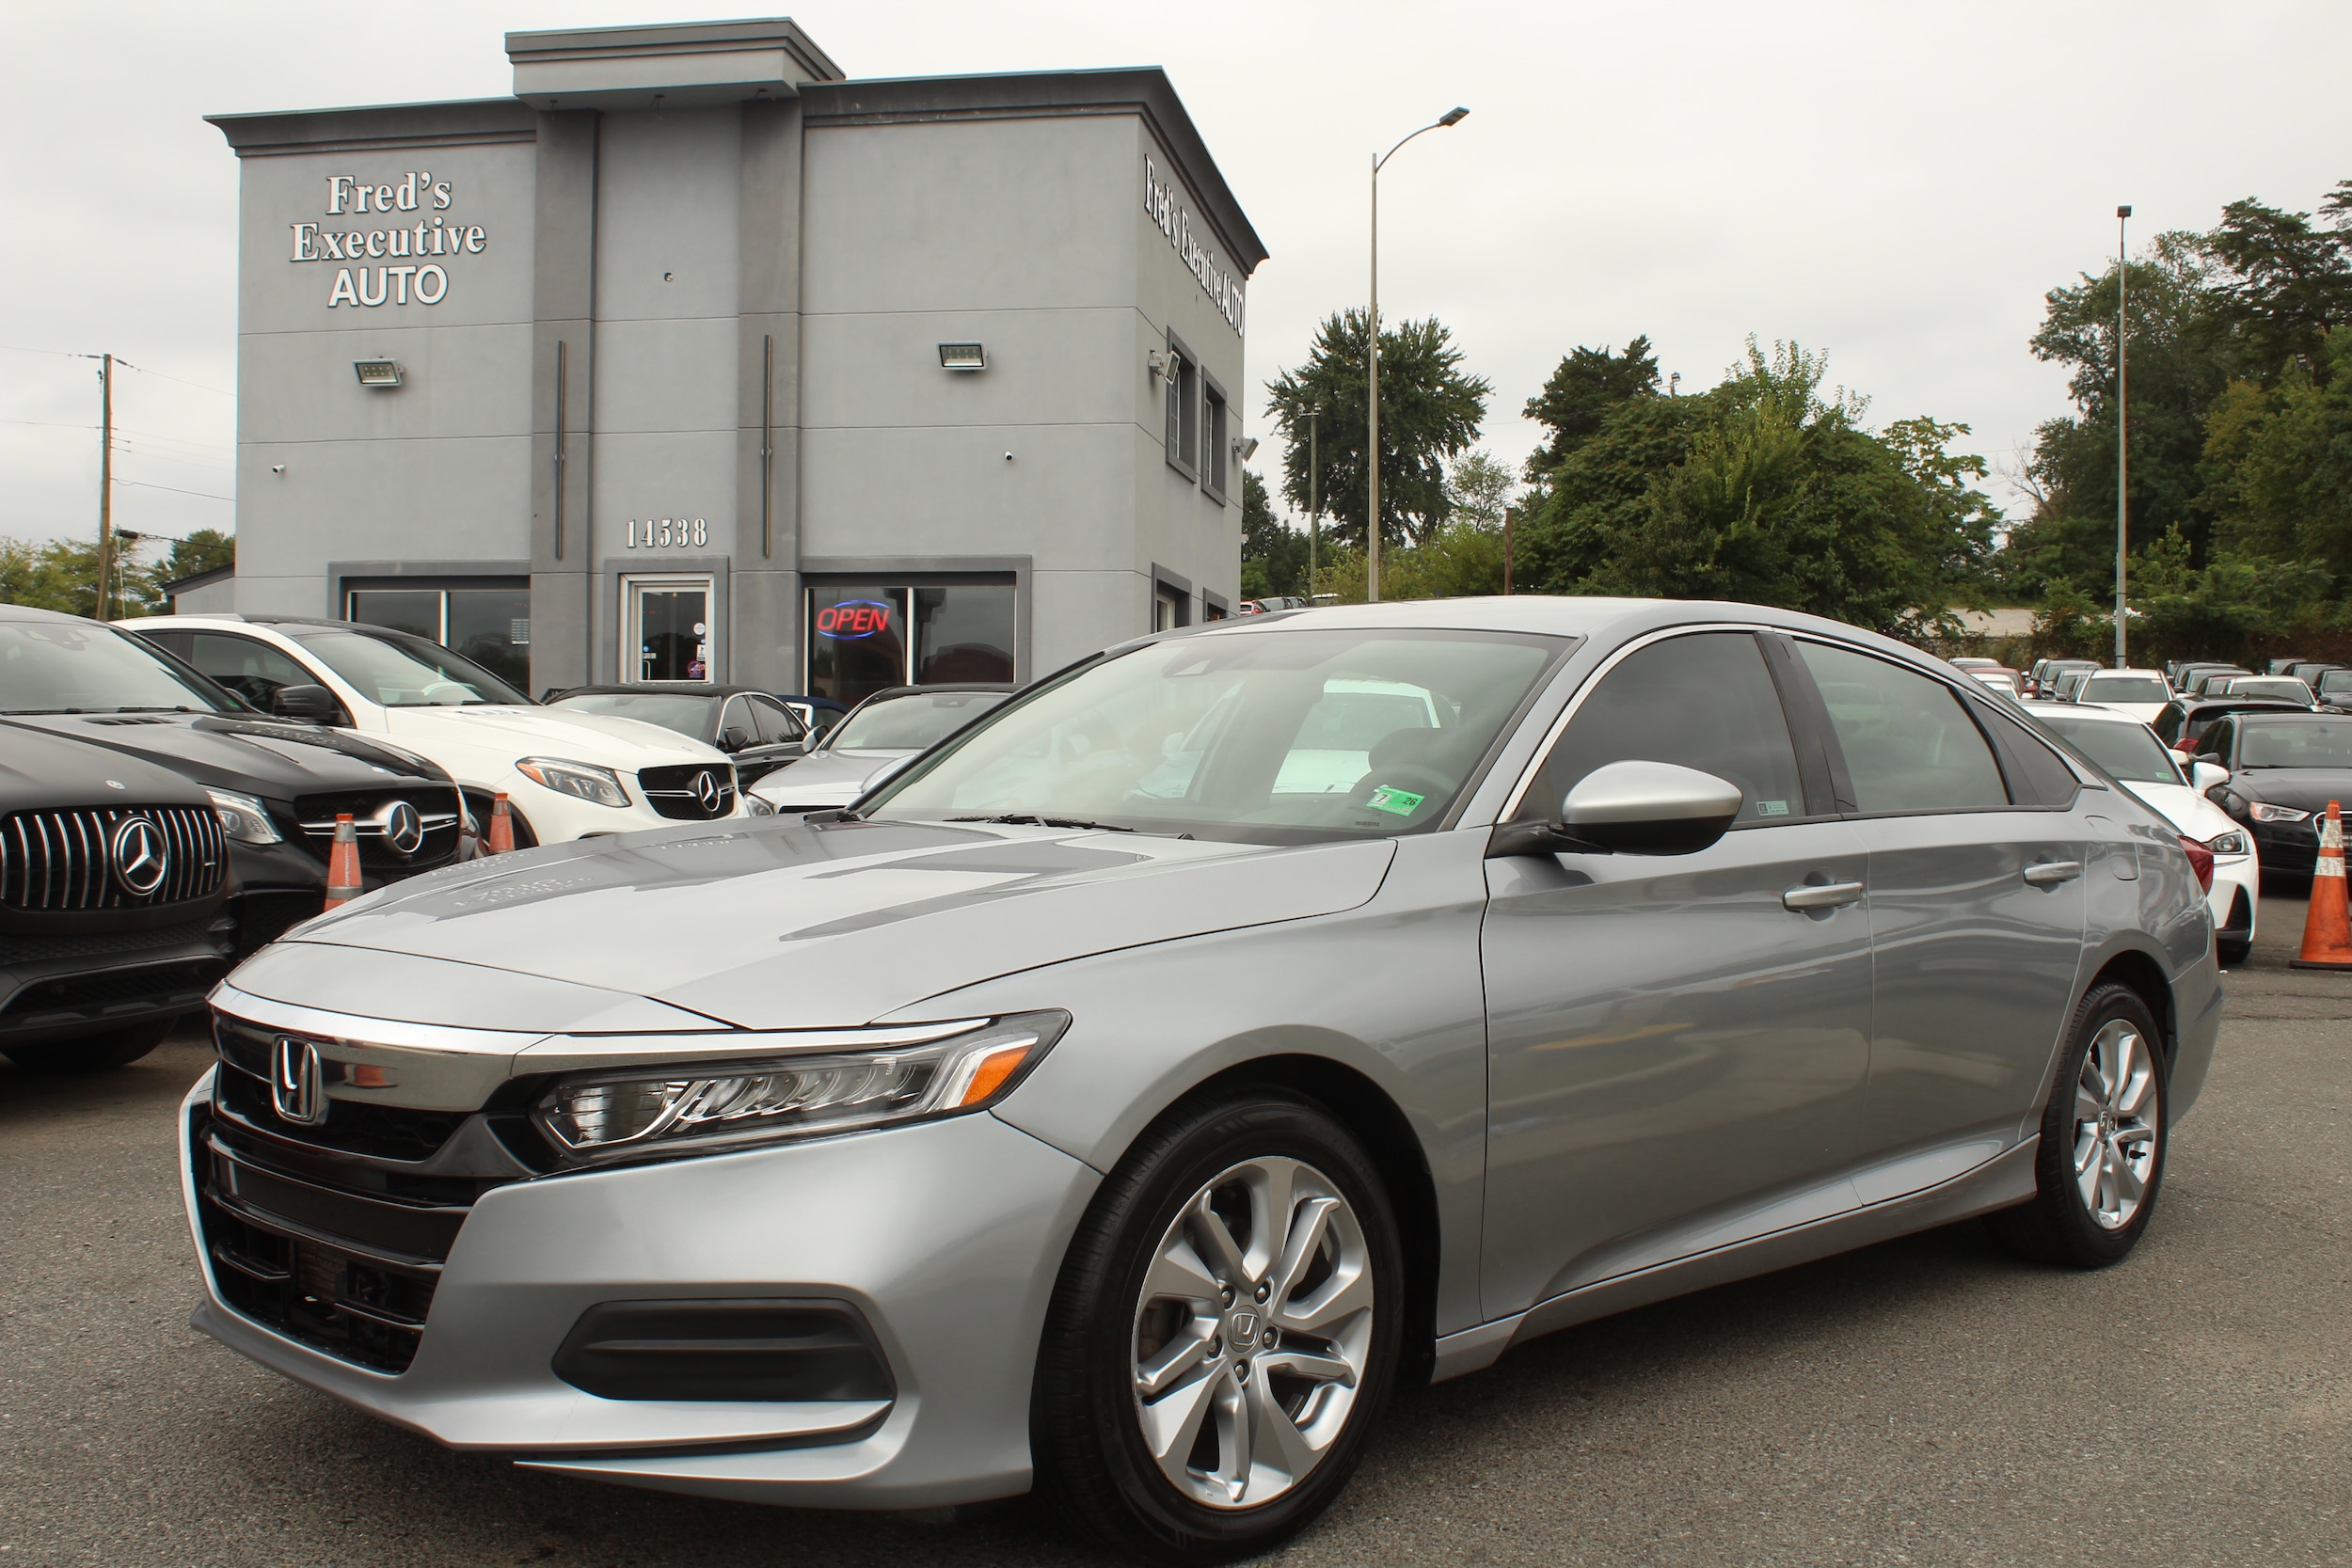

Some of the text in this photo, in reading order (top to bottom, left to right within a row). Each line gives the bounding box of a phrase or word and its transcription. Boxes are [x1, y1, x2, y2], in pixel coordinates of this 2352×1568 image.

[326, 171, 452, 215] Fred's
[289, 216, 487, 262] Executive
[1145, 154, 1245, 338] Fred's Executive AUTO
[327, 263, 450, 308] AUTO
[627, 517, 708, 548] 14538
[816, 607, 891, 631] OPEN
[1377, 794, 1418, 805] 7 26
